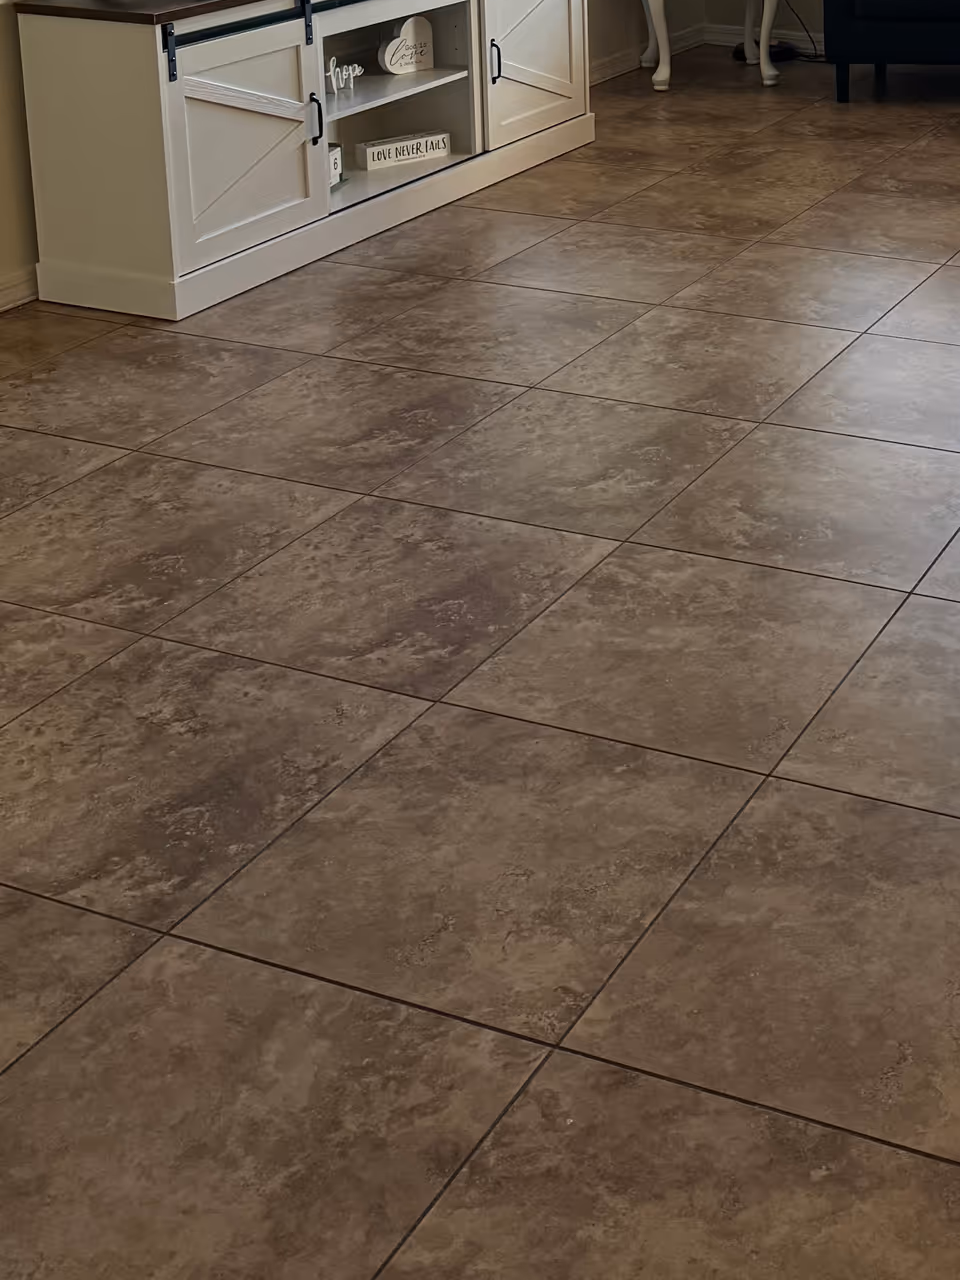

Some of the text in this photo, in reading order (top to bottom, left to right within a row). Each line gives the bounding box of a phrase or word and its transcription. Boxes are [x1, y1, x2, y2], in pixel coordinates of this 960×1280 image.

[325, 56, 364, 94] hope
[372, 148, 392, 162] LOVE
[395, 141, 424, 159] NEVER
